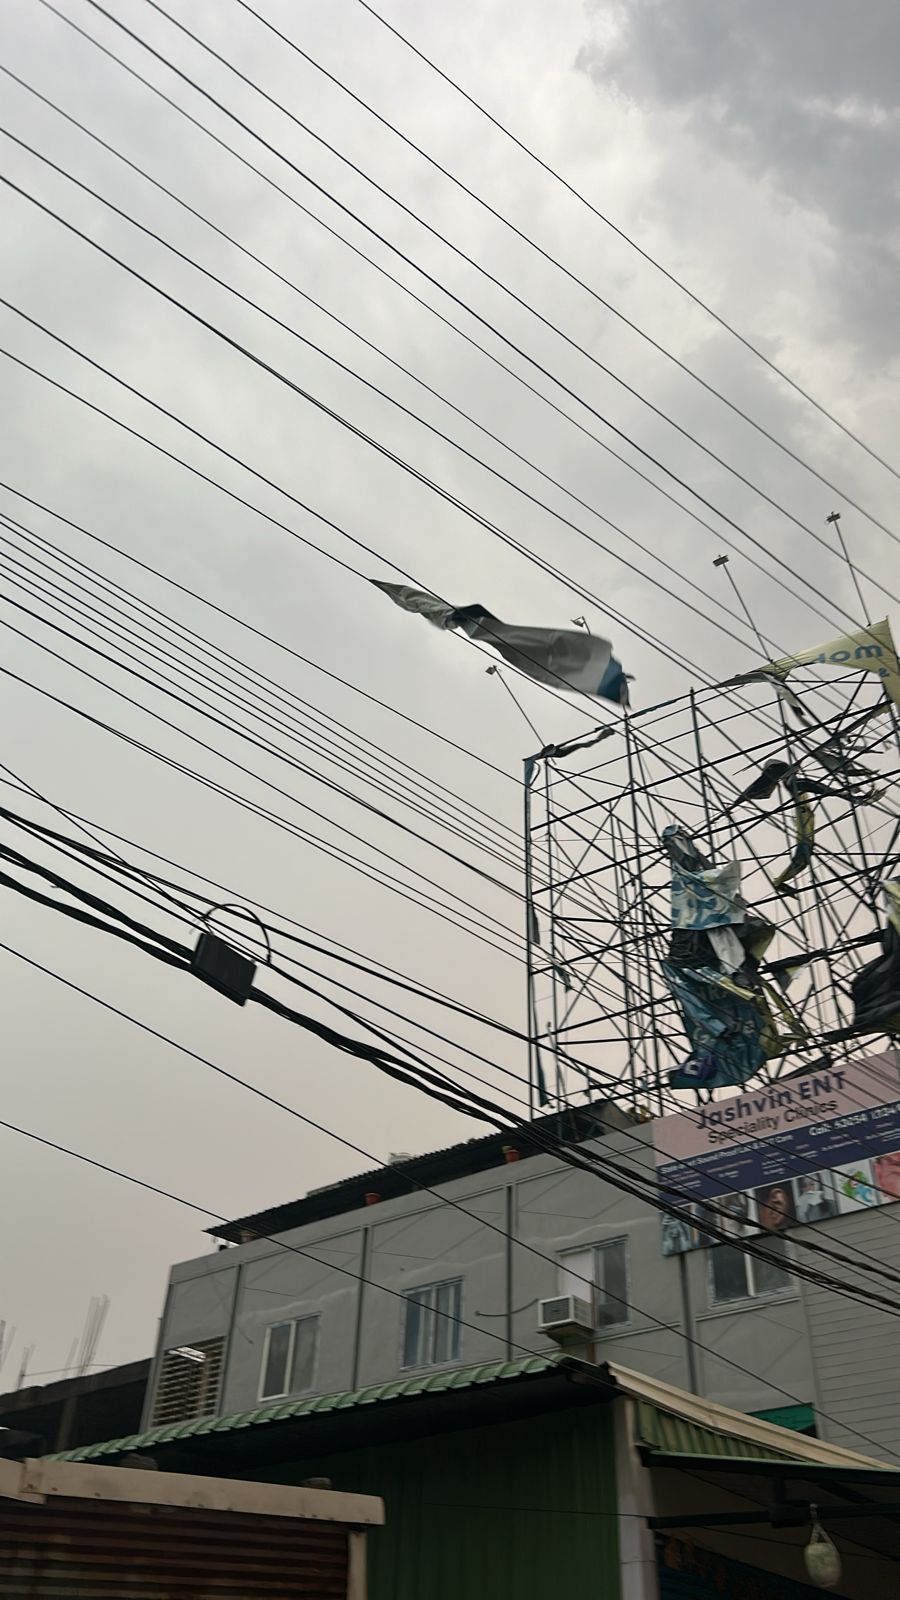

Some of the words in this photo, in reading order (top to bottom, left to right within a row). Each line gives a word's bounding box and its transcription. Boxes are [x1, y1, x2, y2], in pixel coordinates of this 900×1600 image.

[697, 1090, 792, 1130] Jashvin
[798, 1071, 845, 1099] ENT
[708, 1116, 780, 1144] Speciality
[784, 1100, 838, 1123] Clinics
